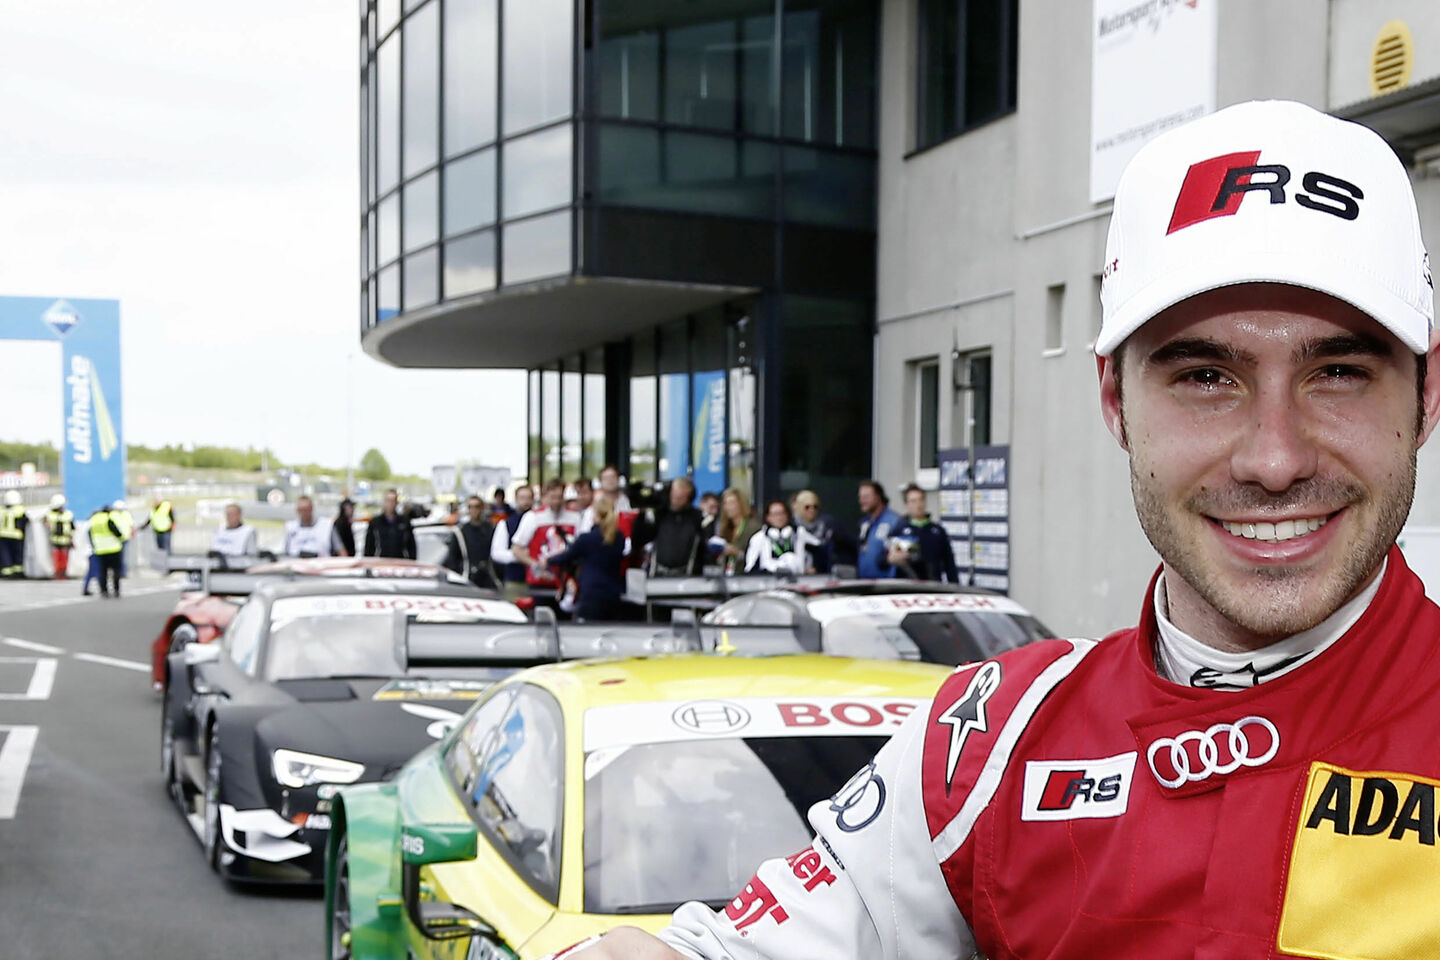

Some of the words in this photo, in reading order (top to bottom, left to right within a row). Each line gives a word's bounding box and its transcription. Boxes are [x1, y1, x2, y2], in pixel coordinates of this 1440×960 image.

[1209, 164, 1364, 220] RS
[66, 355, 92, 464] ultimate
[364, 599, 487, 614] BOSCH
[892, 597, 996, 609] BOSCH
[1060, 773, 1122, 803] RS
